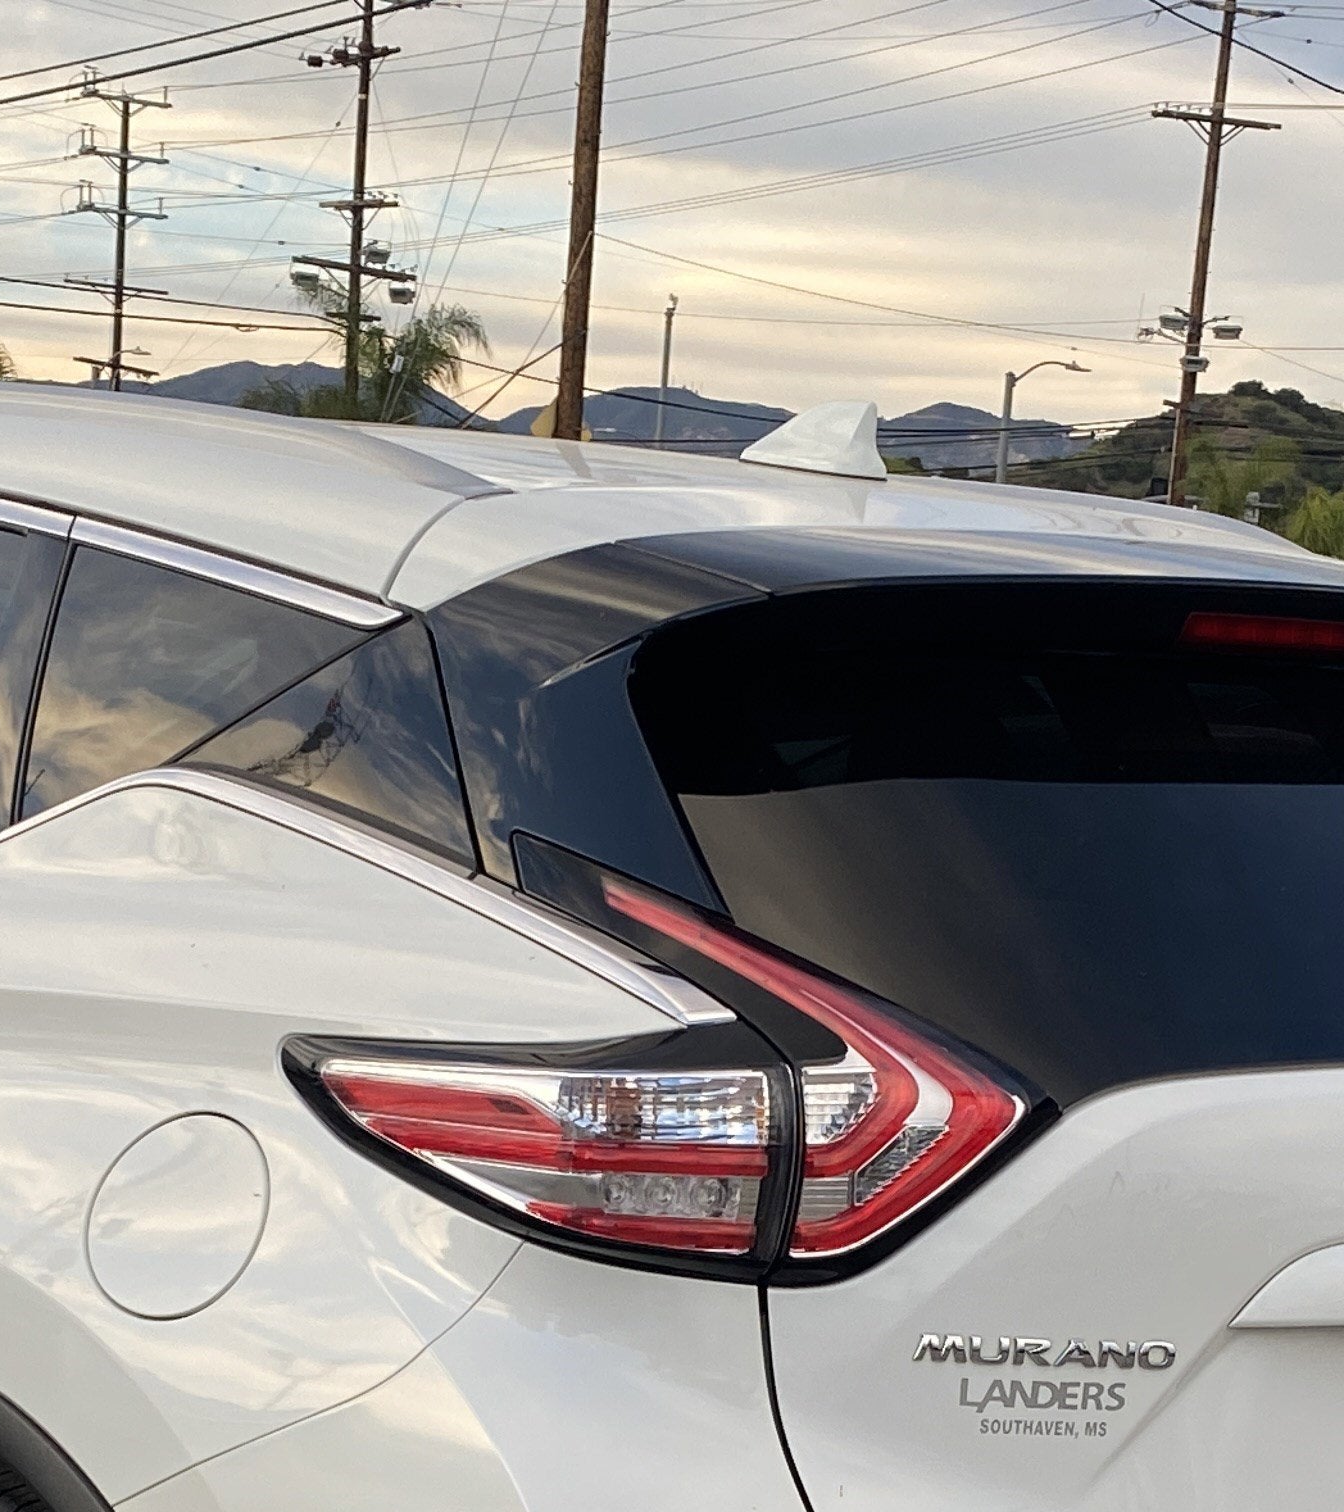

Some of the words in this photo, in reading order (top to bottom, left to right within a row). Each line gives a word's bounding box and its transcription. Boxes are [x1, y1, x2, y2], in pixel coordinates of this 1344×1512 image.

[912, 1333, 1177, 1370] MURANO
[959, 1377, 1127, 1413] LANDERS
[979, 1418, 1080, 1439] SOUTHAVEN,
[1084, 1421, 1108, 1437] MS
